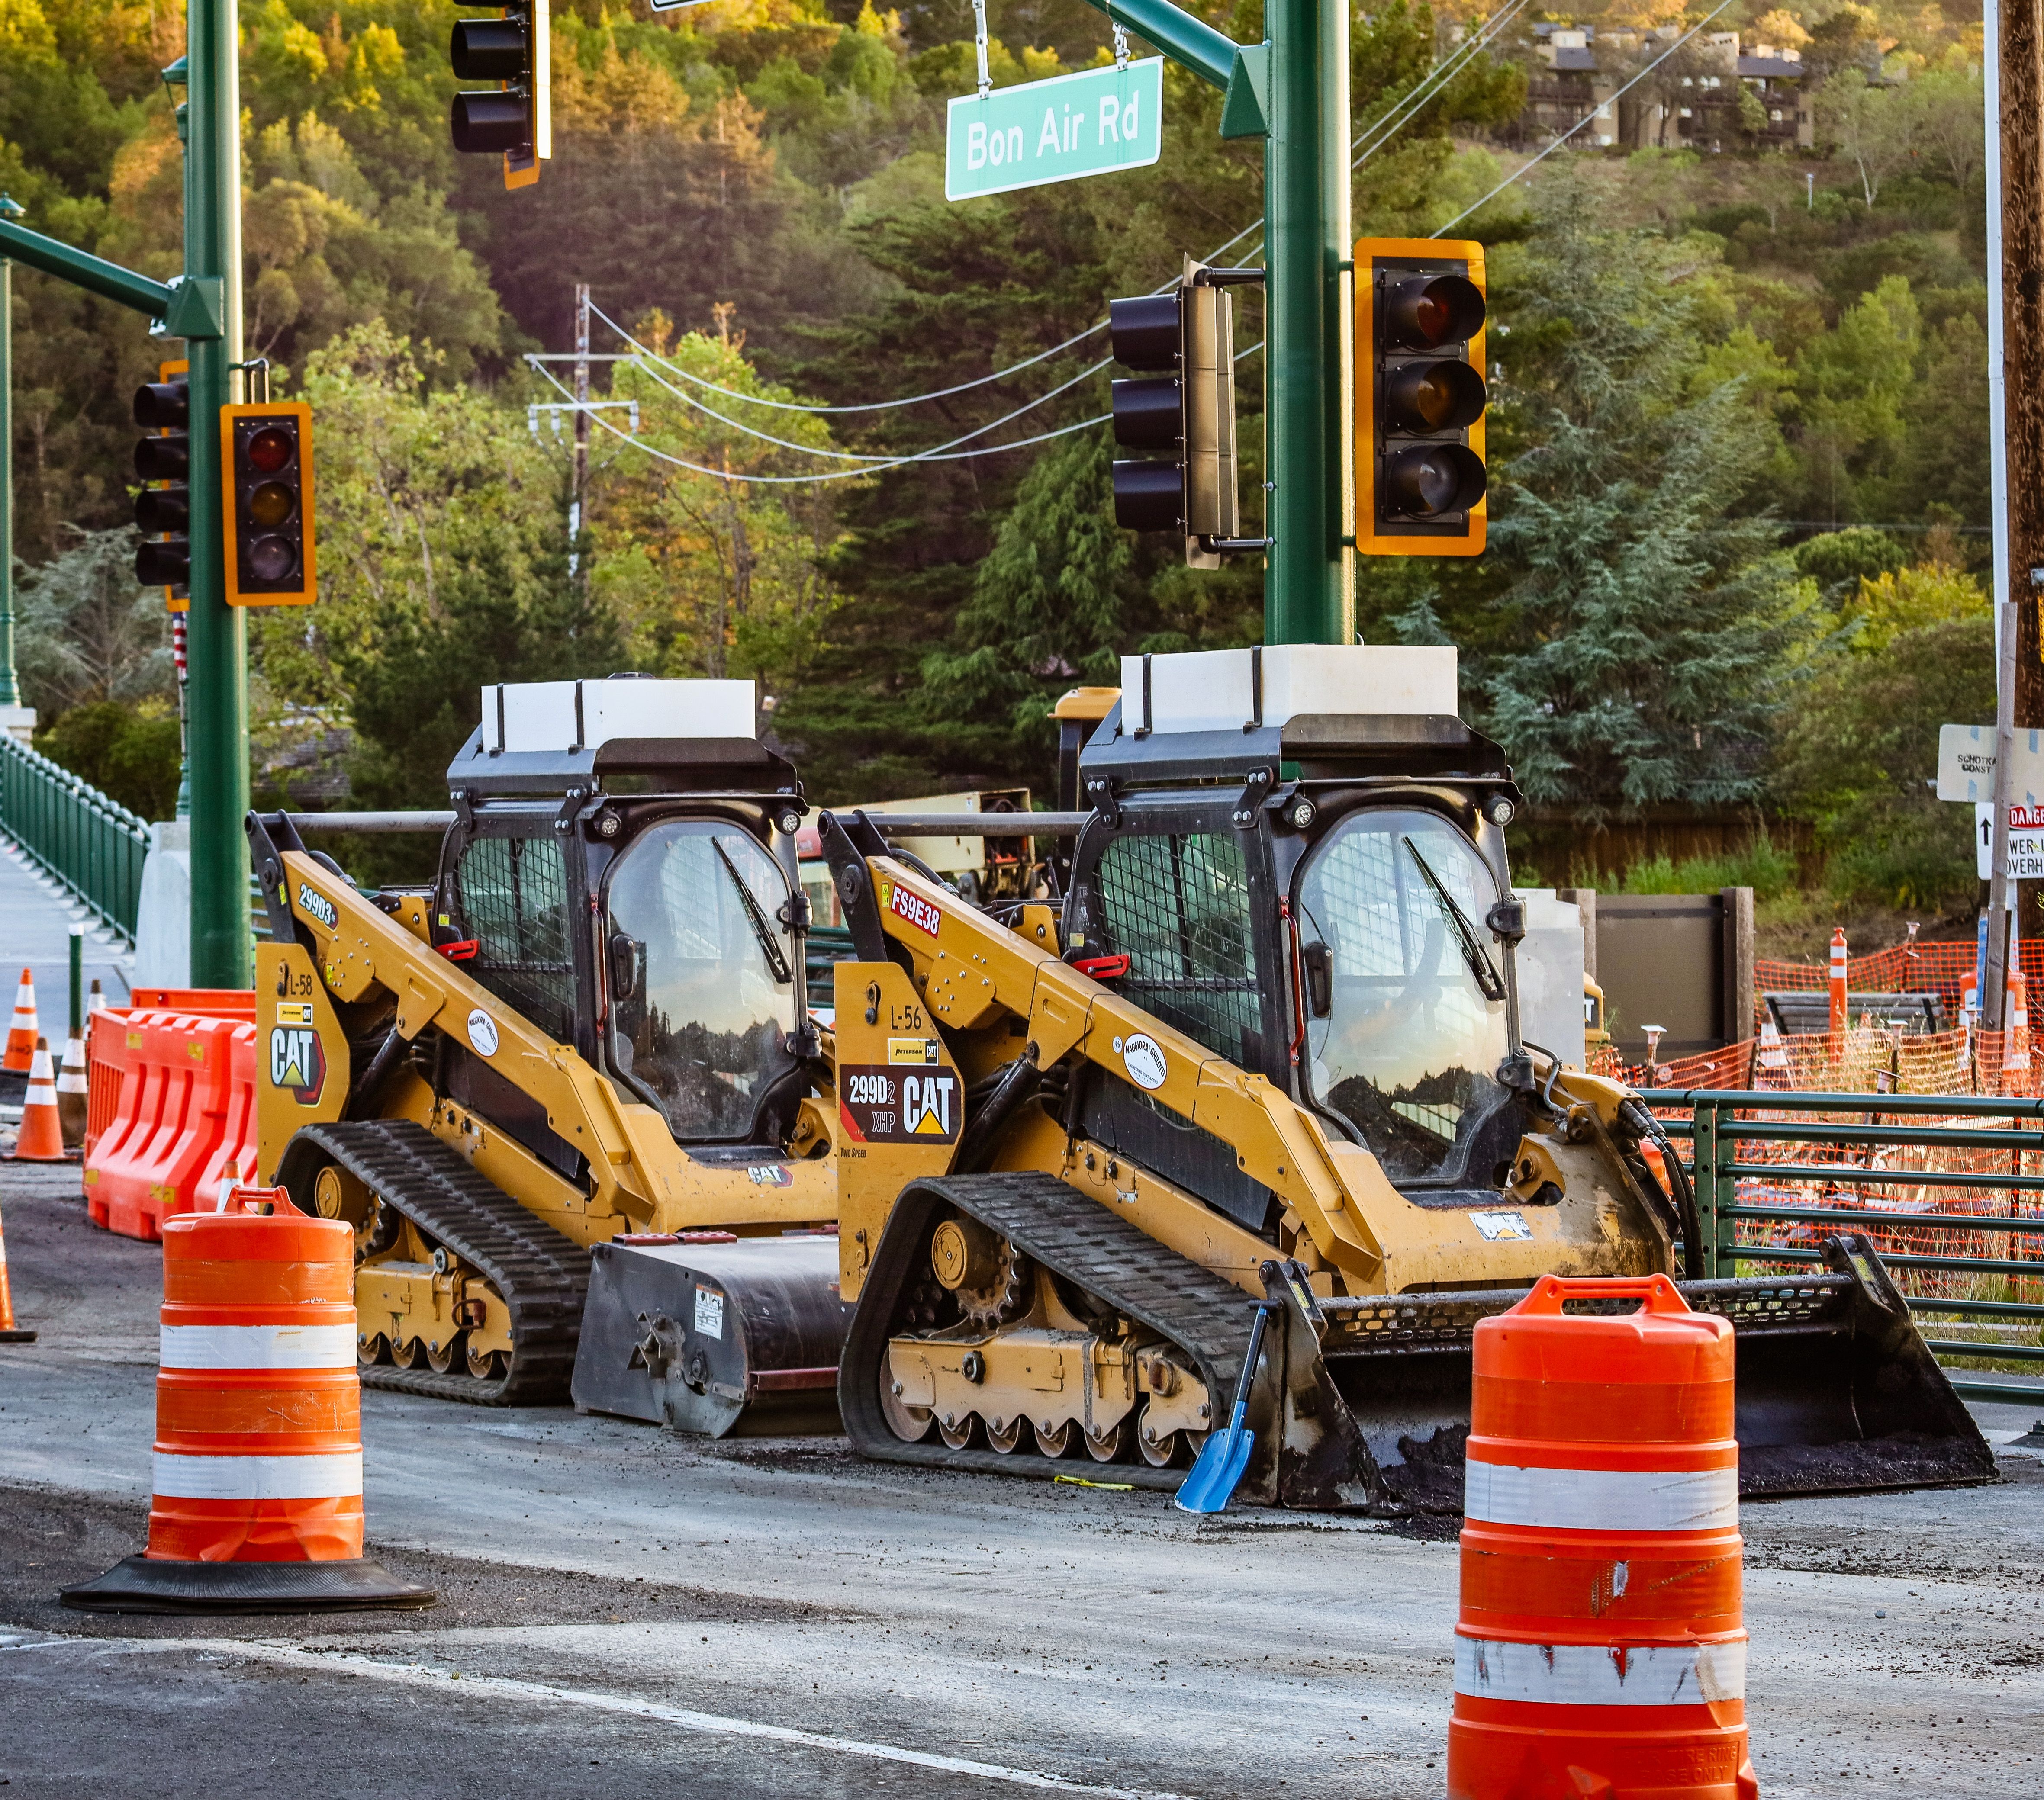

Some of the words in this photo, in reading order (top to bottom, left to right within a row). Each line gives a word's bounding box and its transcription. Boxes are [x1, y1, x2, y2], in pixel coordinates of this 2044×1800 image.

[968, 121, 1024, 171] Bon
[1036, 103, 1085, 158] Air
[1098, 89, 1139, 145] Rd
[299, 883, 332, 925] 299D3
[892, 885, 939, 935] FS9E38
[290, 974, 312, 996] L-58
[891, 1005, 922, 1030] L-56
[271, 1028, 313, 1087] CAT
[926, 1045, 937, 1058] CAT
[1125, 1040, 1149, 1054] MAGGIORA
[1150, 1047, 1165, 1077] GHILOTTI
[849, 1075, 895, 1105] 299D2
[903, 1075, 953, 1135] CAT
[872, 1111, 895, 1133] XHP
[747, 1164, 782, 1183] CAT
[1709, 1745, 1737, 1763] RING
[1693, 1765, 1729, 1783] ONLY
